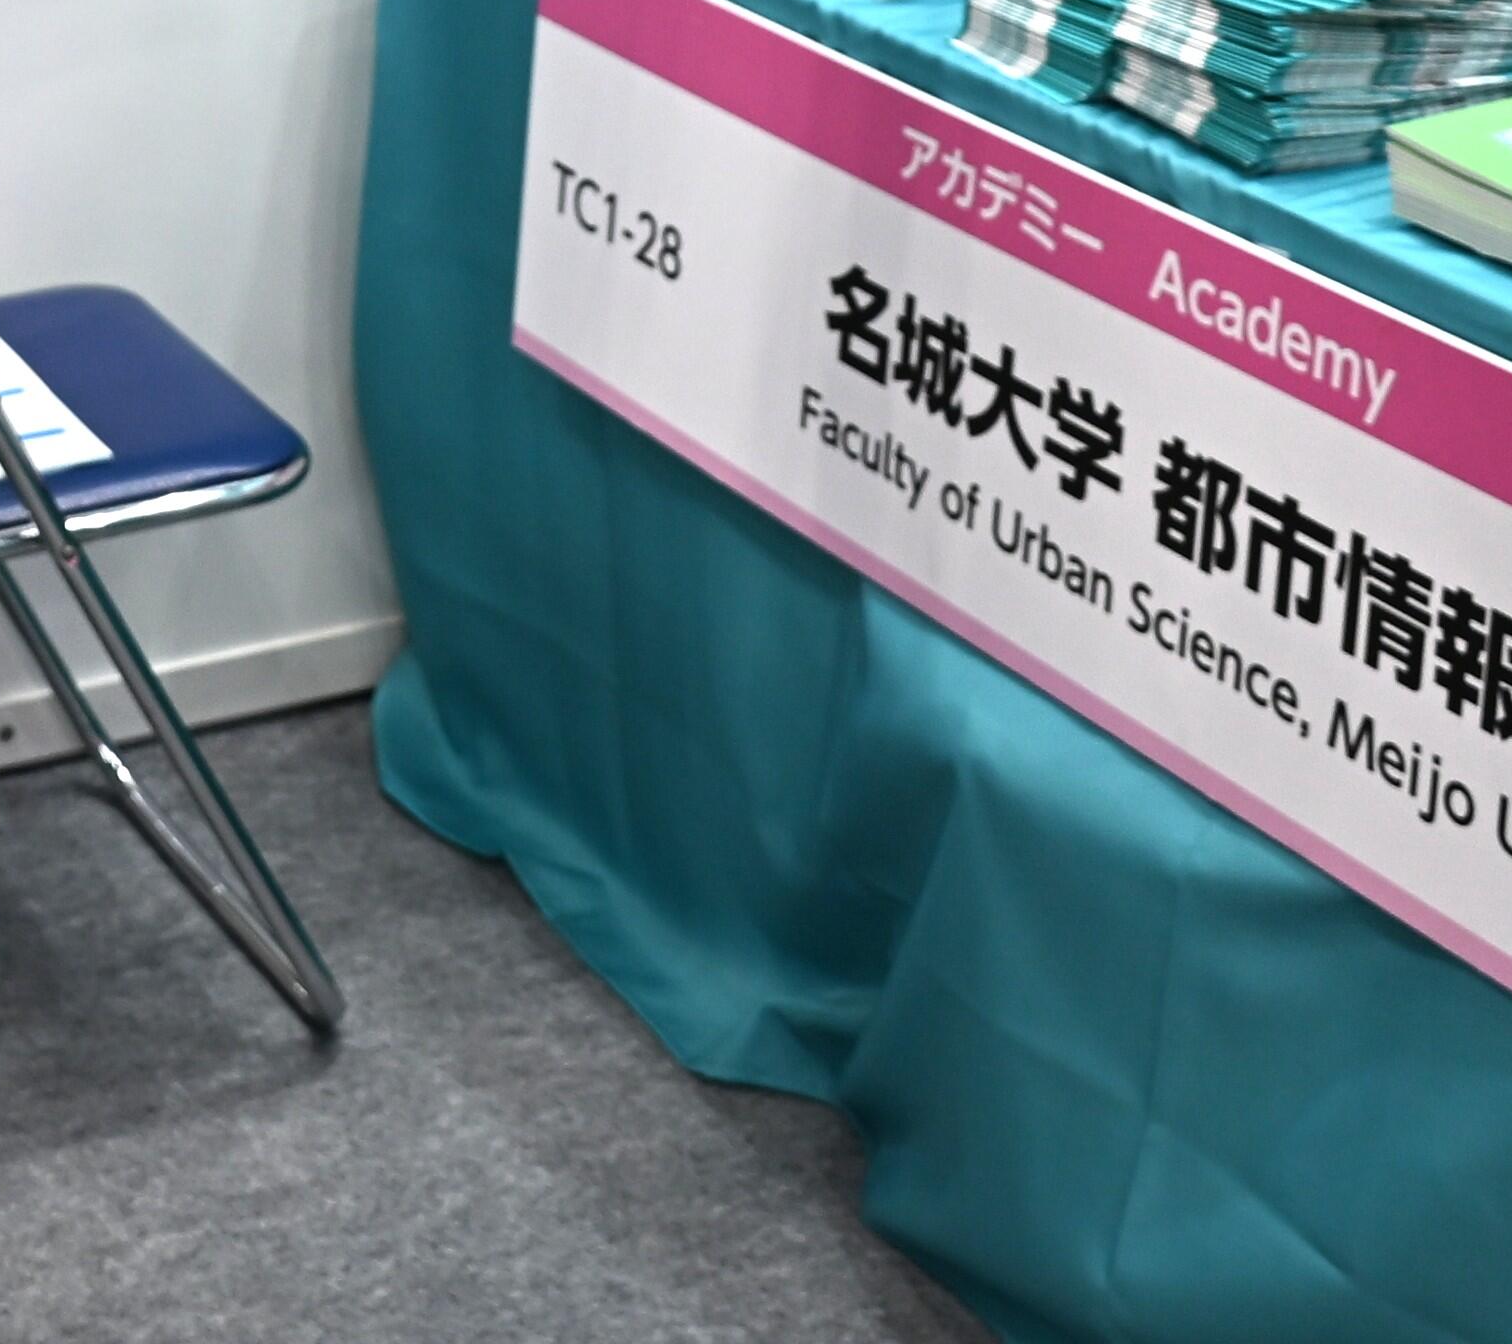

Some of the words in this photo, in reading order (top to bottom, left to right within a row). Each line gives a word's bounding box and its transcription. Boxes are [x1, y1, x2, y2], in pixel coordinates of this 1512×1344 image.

[550, 159, 685, 283] TC1-28
[899, 126, 1106, 255] アカデミー
[1149, 248, 1397, 425] Academy
[824, 264, 1126, 502] 名城大学
[798, 386, 931, 512] Faculty
[940, 479, 980, 530] of
[991, 497, 1114, 614] Urban
[1127, 583, 1314, 739] Science,
[1328, 698, 1477, 828] Meijo
